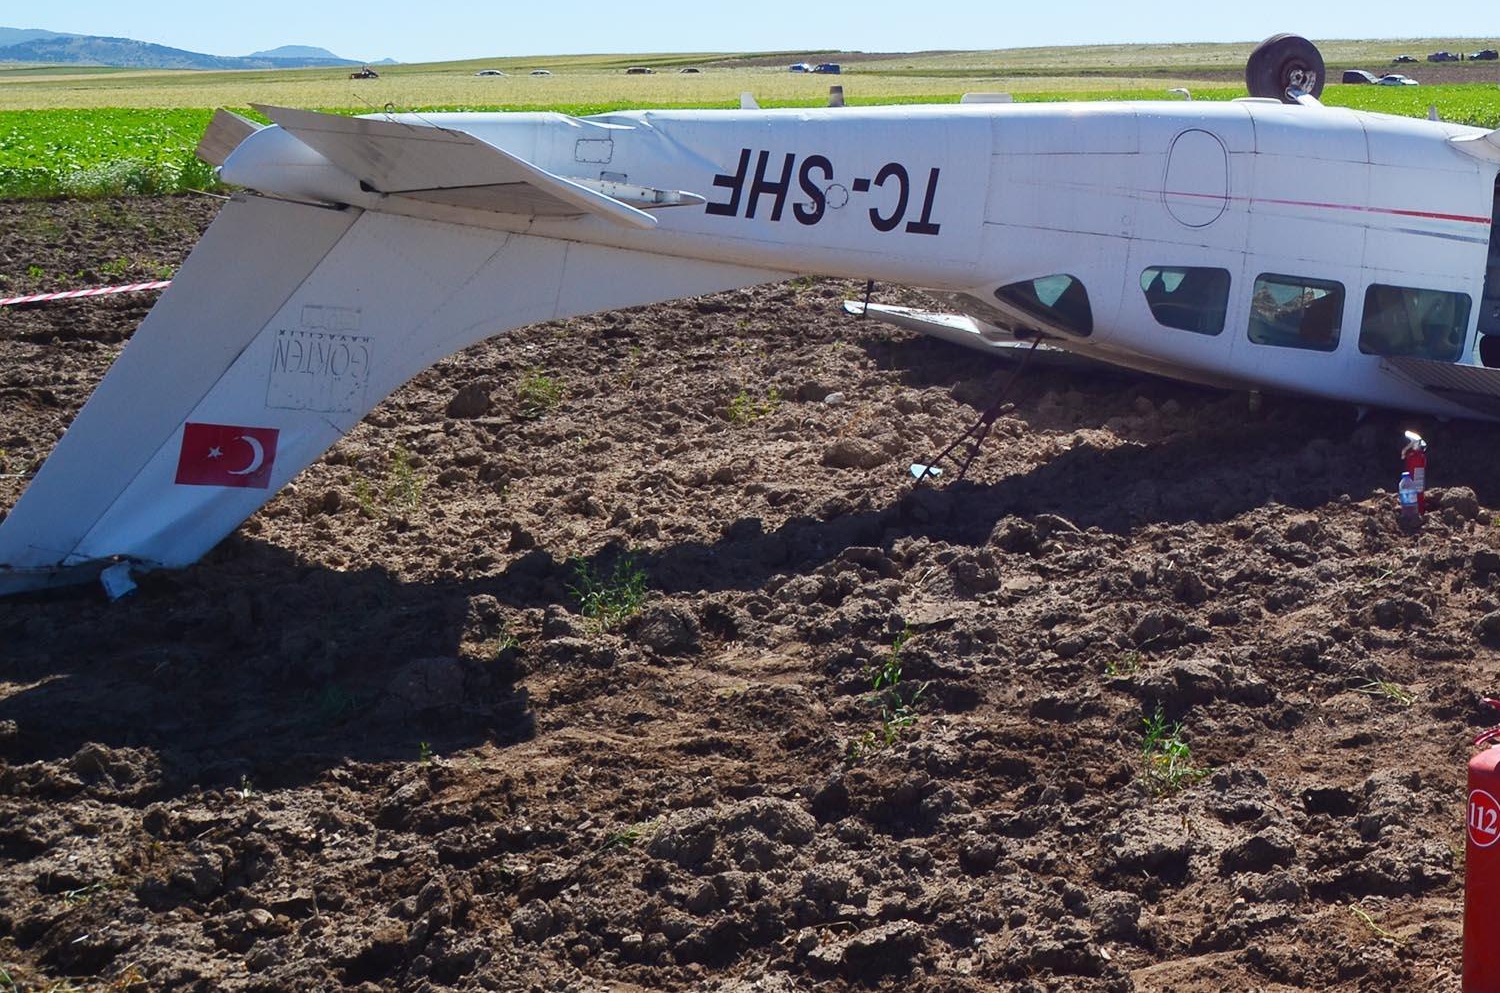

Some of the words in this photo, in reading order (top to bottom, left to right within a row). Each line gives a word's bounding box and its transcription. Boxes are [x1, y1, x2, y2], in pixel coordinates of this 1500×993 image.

[705, 148, 941, 236] TC-SHF
[274, 339, 370, 382] GÖKTEN
[1469, 802, 1498, 835] 112
